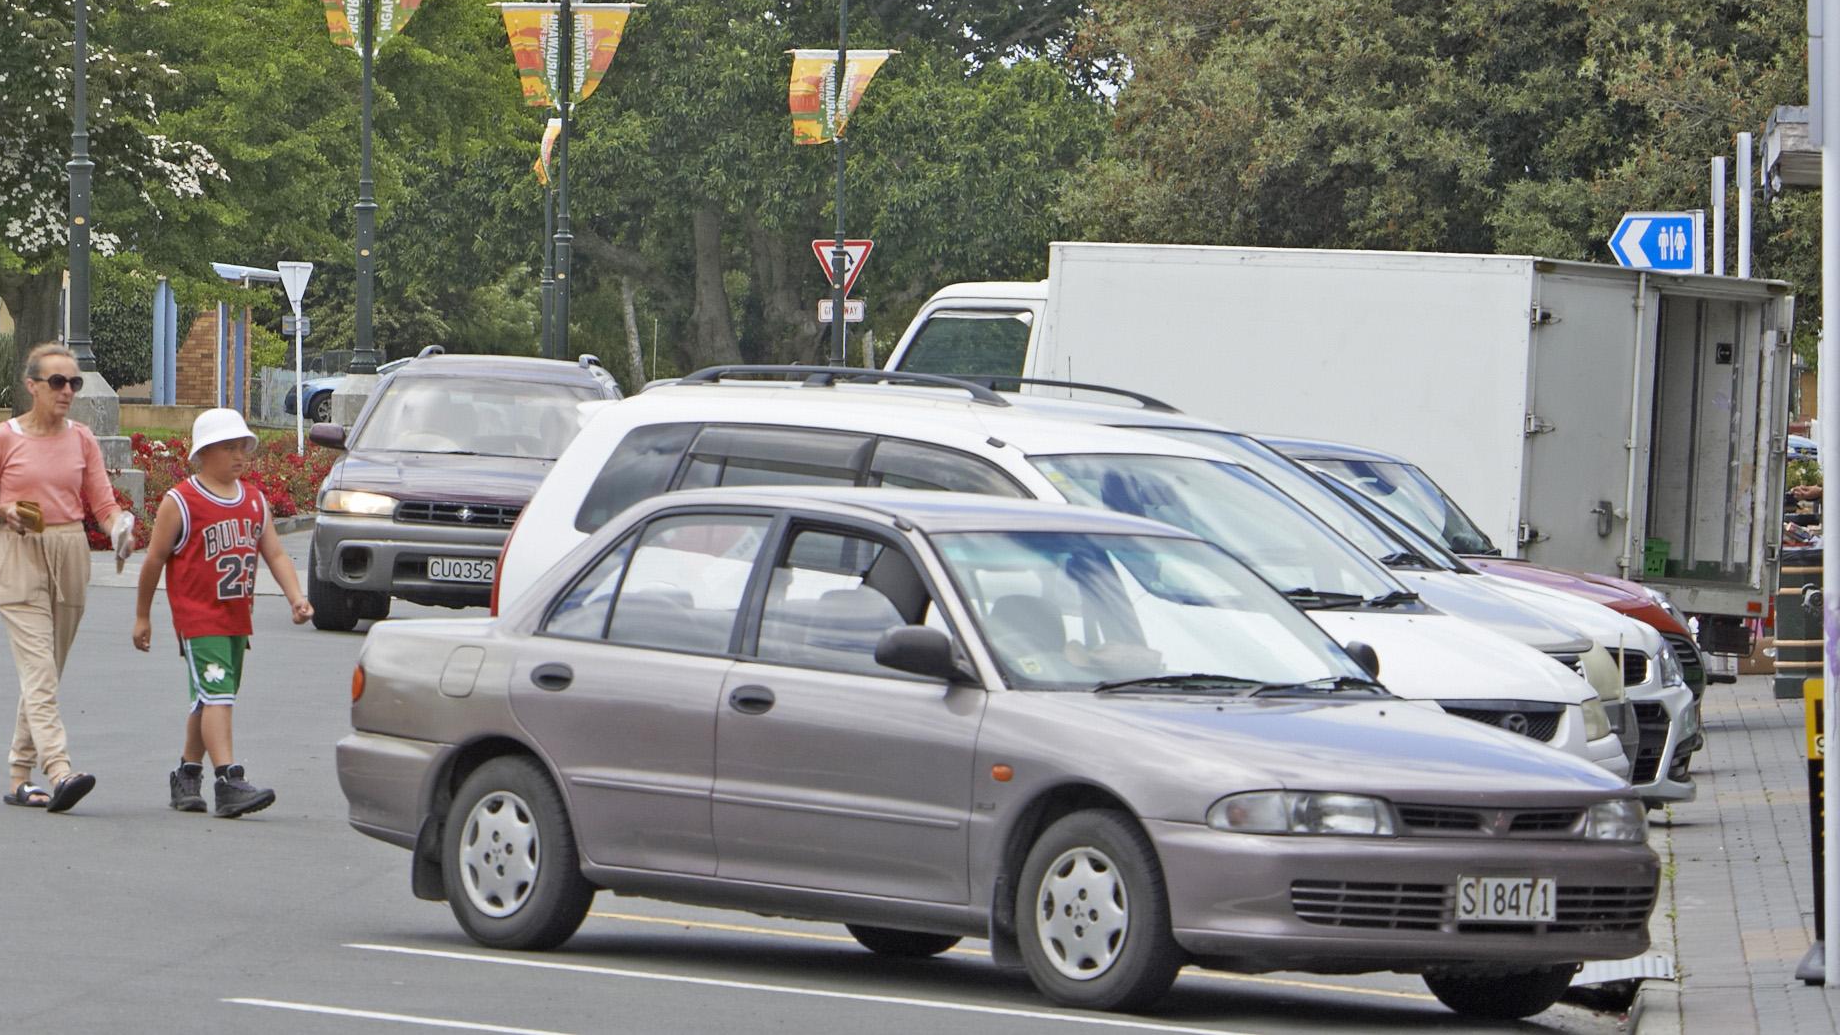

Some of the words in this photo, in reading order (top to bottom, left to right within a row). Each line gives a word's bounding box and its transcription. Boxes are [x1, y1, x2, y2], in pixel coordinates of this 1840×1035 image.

[587, 51, 593, 61] TO
[216, 553, 256, 601] 23
[430, 560, 493, 581] CUQ352
[1462, 882, 1550, 917] SI8471
